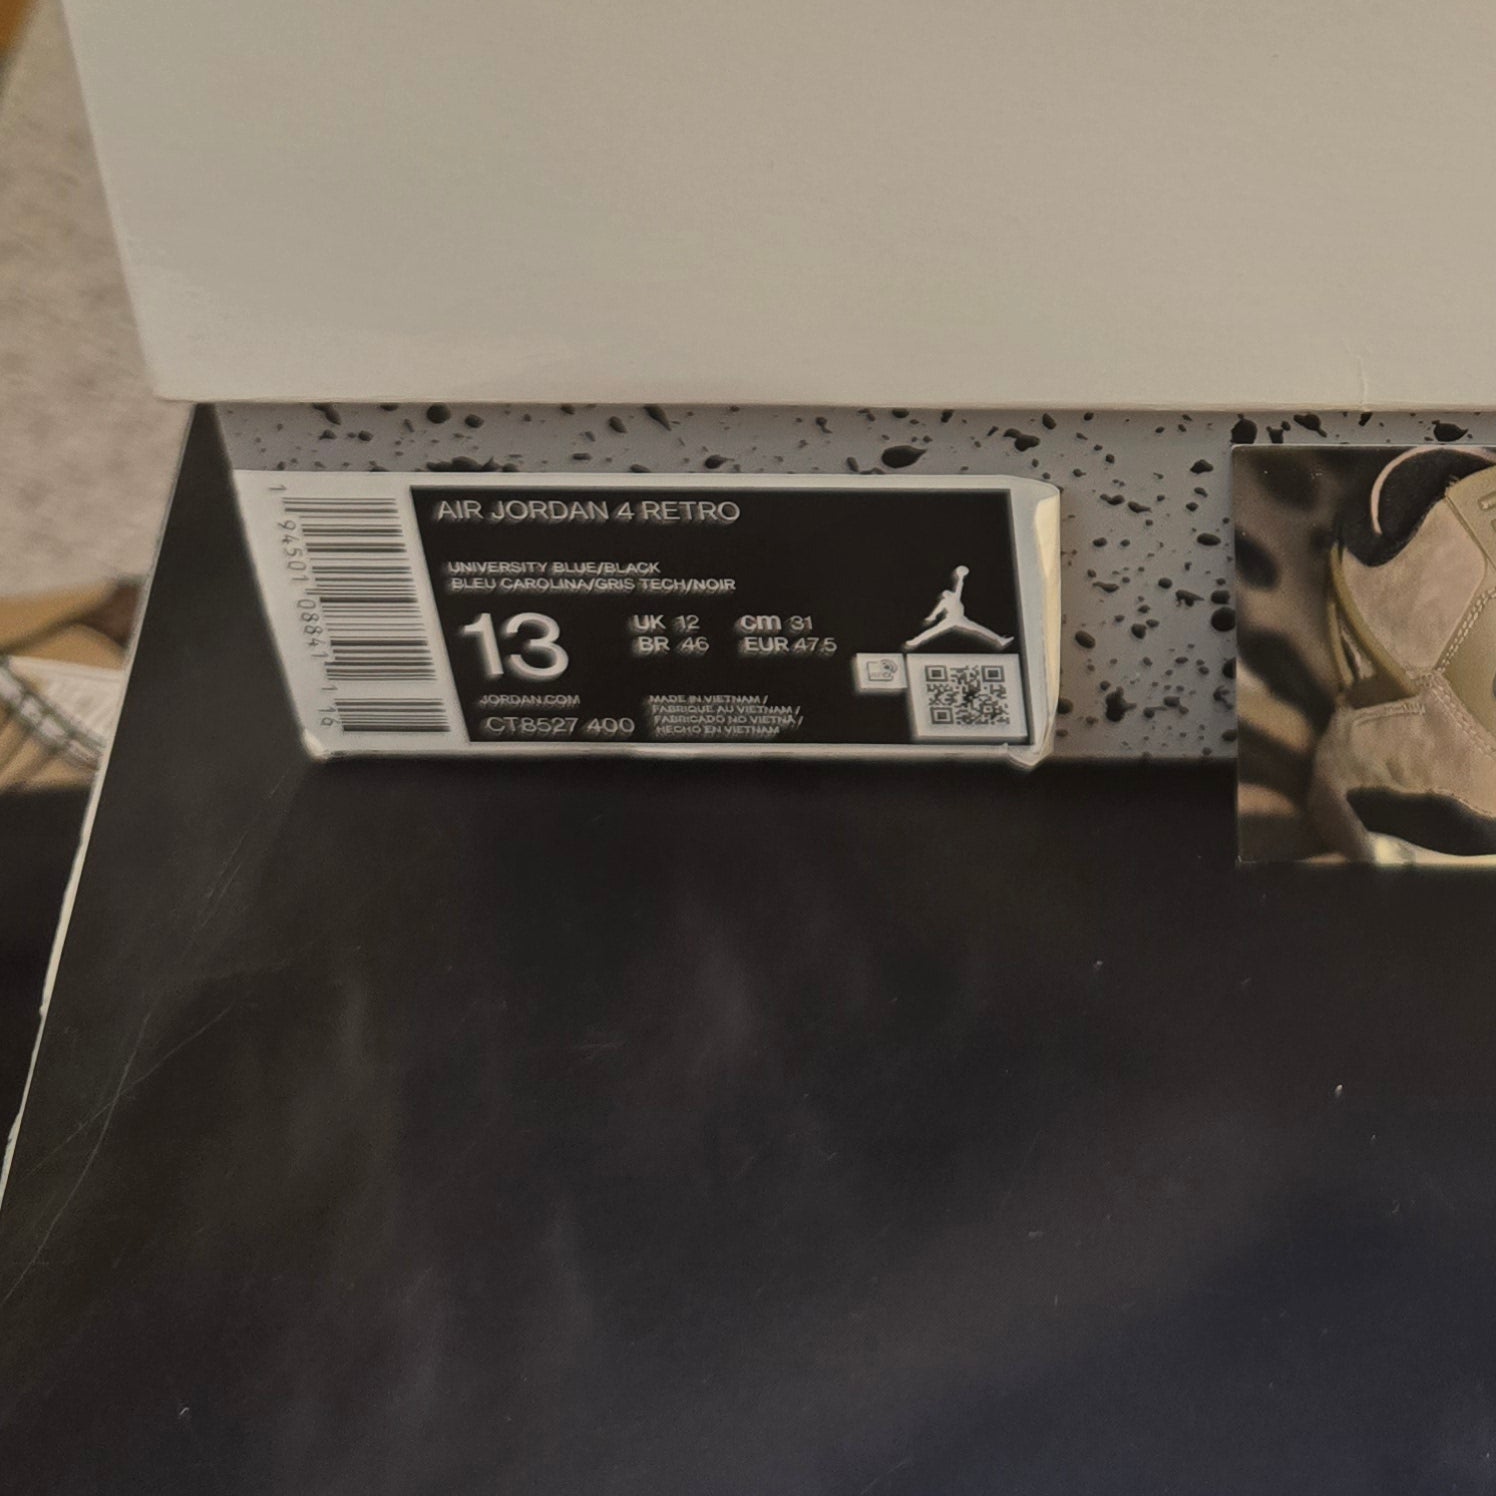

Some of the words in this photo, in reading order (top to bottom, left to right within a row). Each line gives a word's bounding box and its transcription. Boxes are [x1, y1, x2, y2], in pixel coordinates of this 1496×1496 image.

[437, 500, 483, 521] AIR
[491, 500, 610, 521] JORDAN
[616, 501, 635, 521] 4
[640, 501, 741, 522] RETRO
[448, 561, 548, 575] UNIVERSITY
[552, 561, 662, 575] BLUE/BLACK
[277, 518, 310, 584] 94501
[297, 598, 330, 660] 08841
[451, 577, 497, 591] BLEU
[500, 577, 636, 591] CAROLINA/GRIS
[639, 578, 737, 592] TECH/NOIR
[633, 614, 667, 630] UK
[675, 614, 701, 630] 12
[739, 614, 783, 631] cm
[789, 615, 814, 631] 31
[462, 612, 570, 679] 13
[637, 635, 671, 652] BR
[680, 636, 710, 652] 46
[743, 636, 790, 652] EUR
[479, 694, 581, 706] JORDAN.COM
[650, 694, 687, 704] MADE
[485, 716, 579, 733] CT8527
[586, 717, 636, 733] 400
